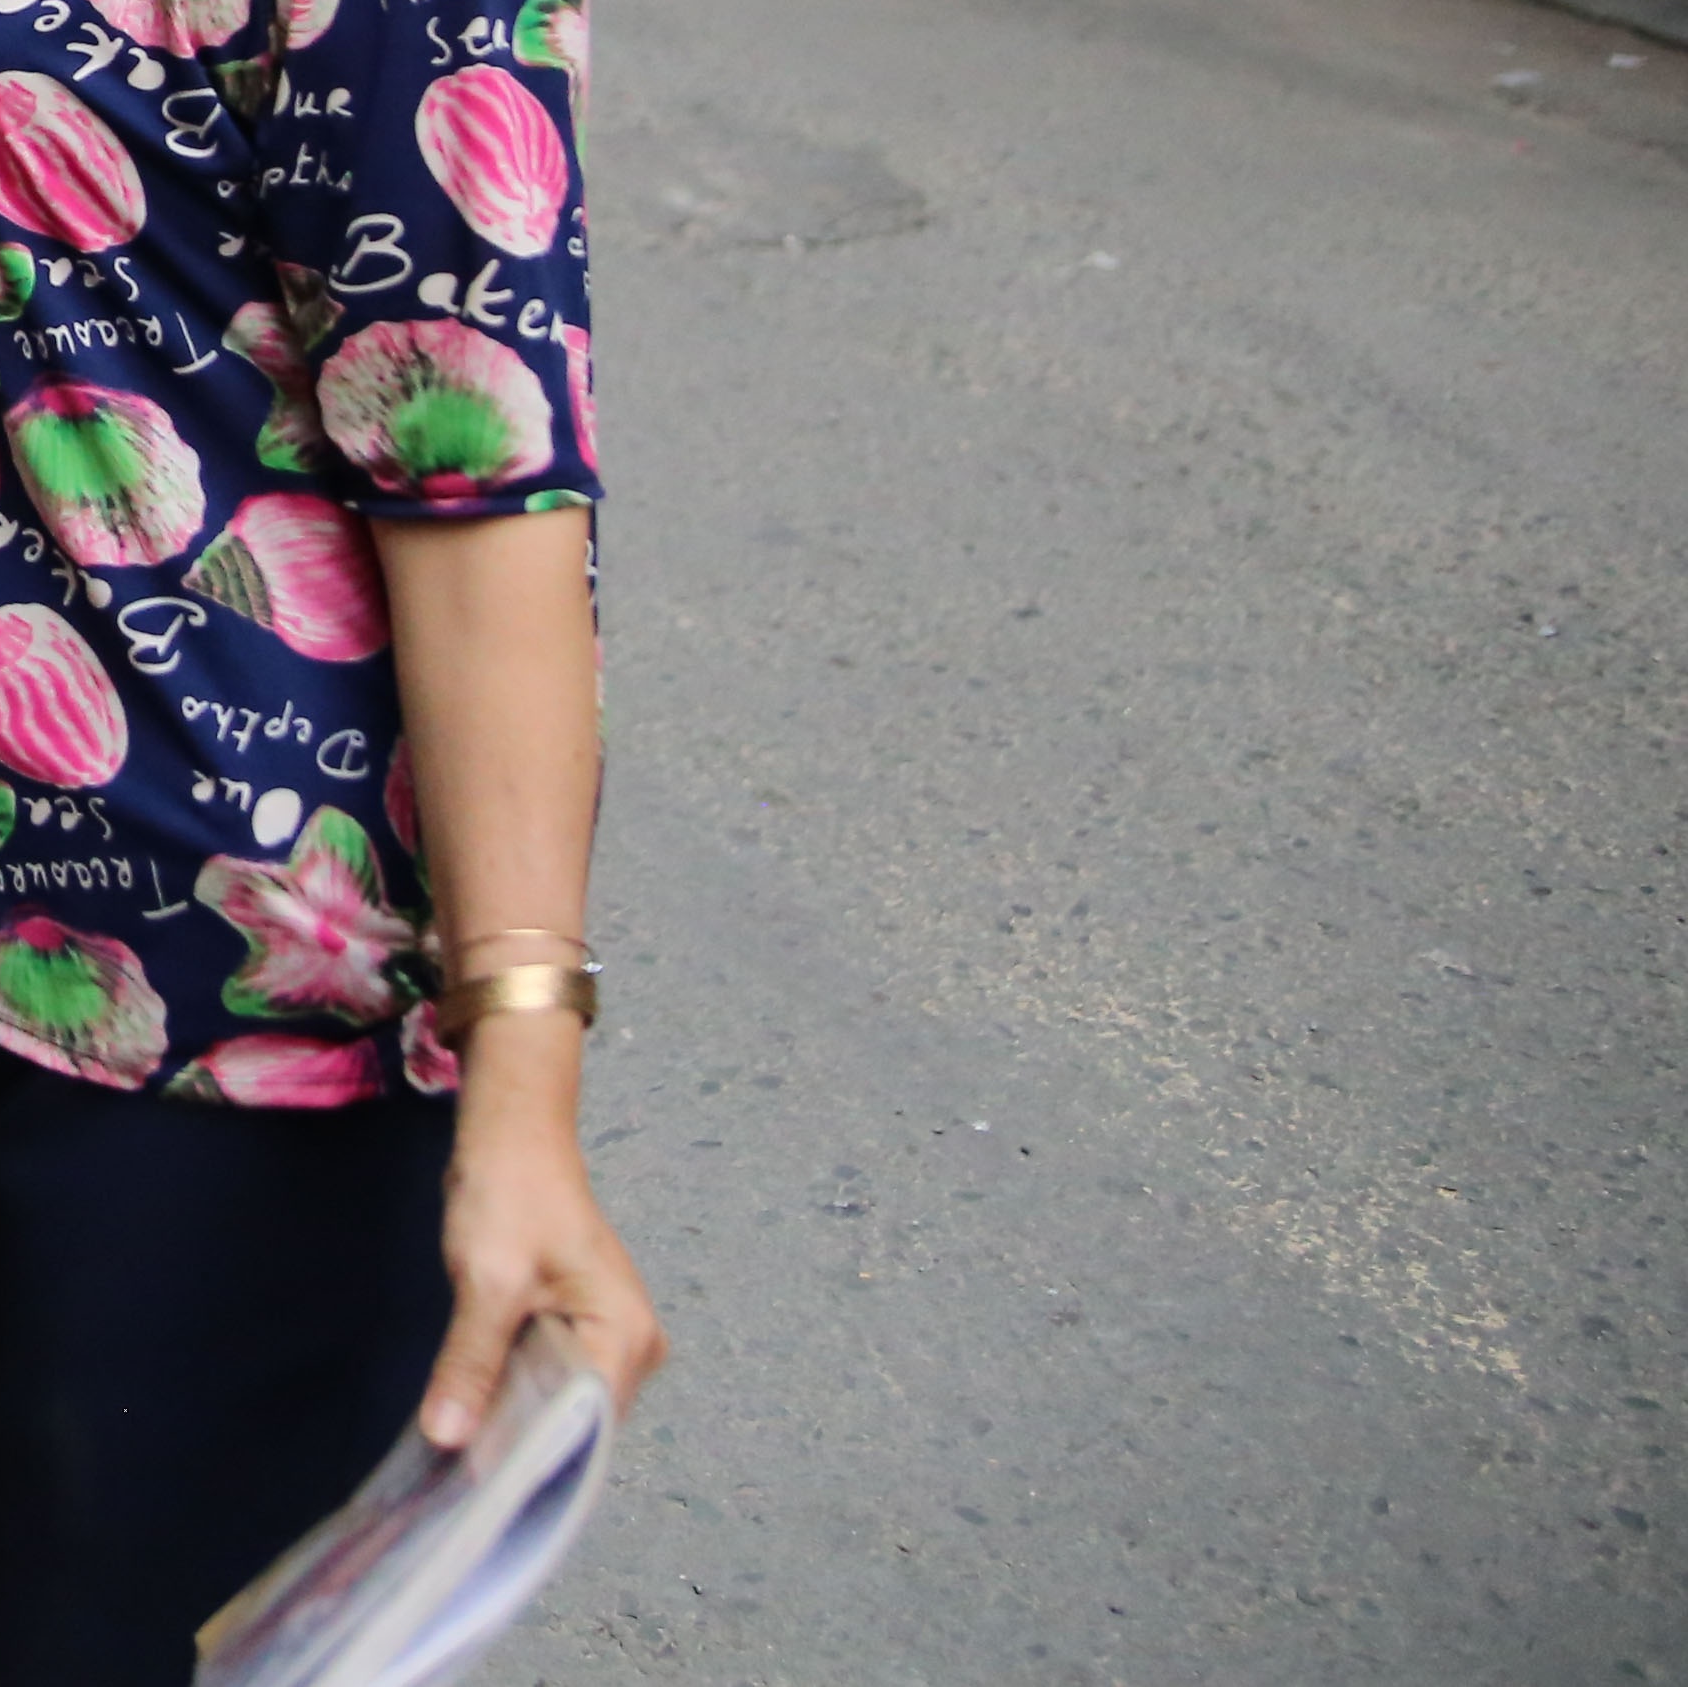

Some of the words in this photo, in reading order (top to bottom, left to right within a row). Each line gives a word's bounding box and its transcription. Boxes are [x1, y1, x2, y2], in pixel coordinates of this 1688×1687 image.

[39, 257, 139, 302] Sea
[13, 312, 218, 374] Treasure
[181, 696, 370, 780] Depths
[22, 797, 114, 841] Sea
[192, 769, 303, 848] Our
